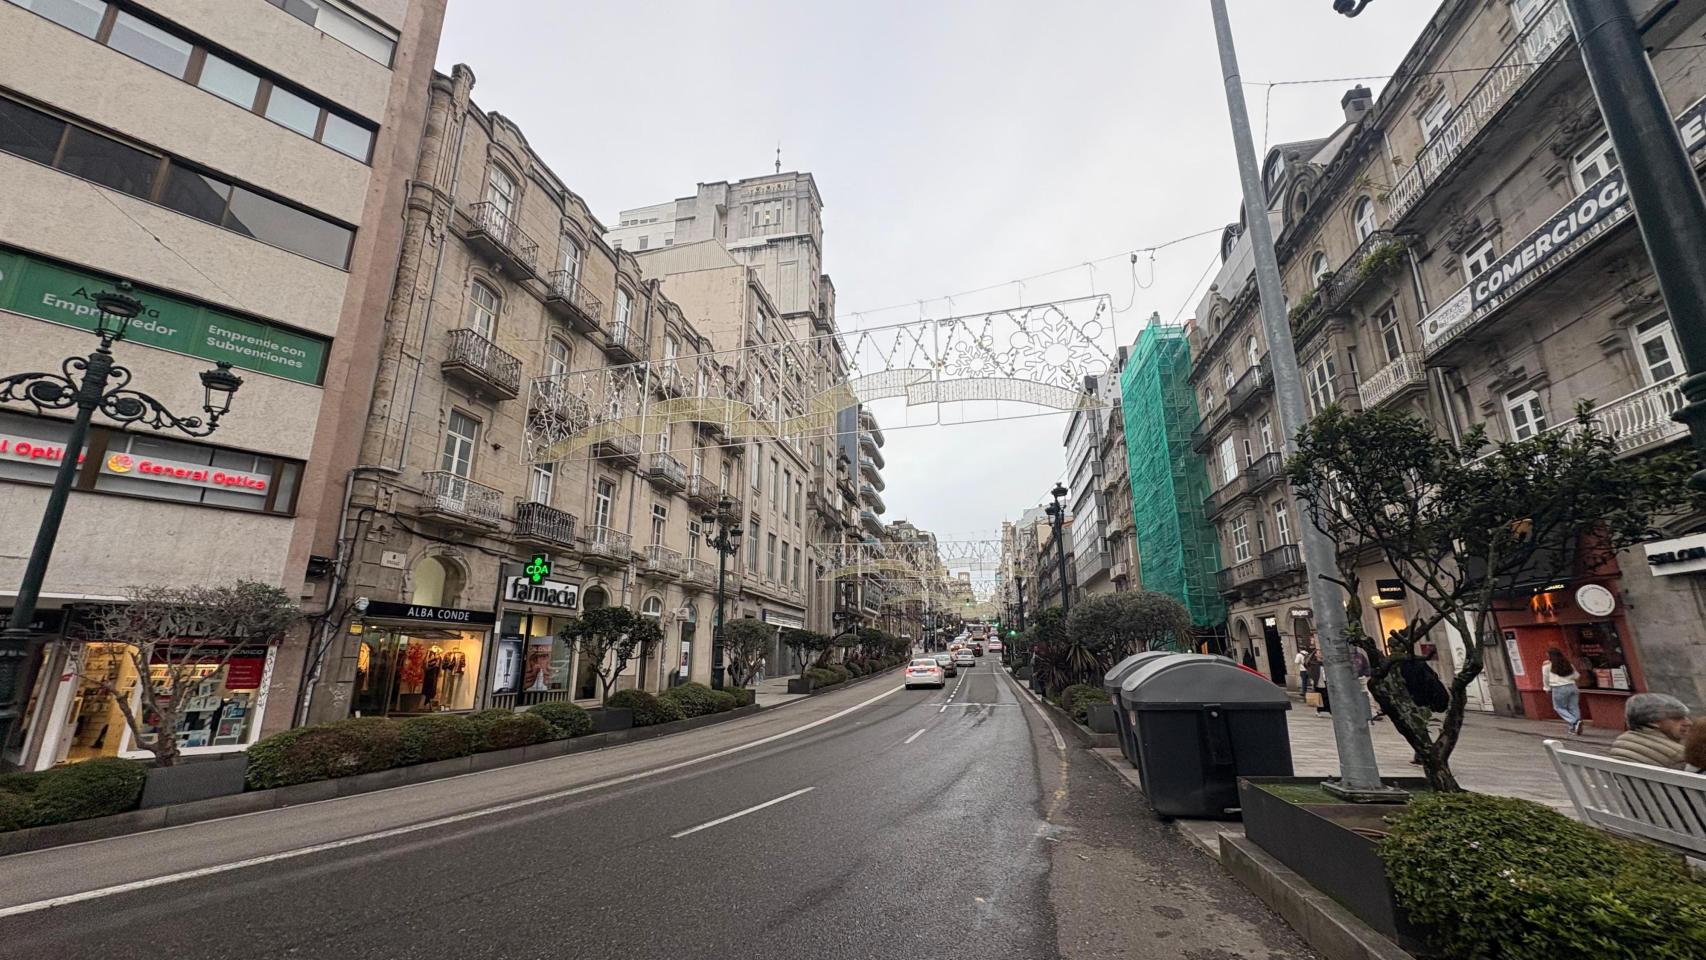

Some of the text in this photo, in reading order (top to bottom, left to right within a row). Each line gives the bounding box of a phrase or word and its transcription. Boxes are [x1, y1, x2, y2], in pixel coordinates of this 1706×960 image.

[206, 336, 304, 369] Subvenciones
[208, 324, 306, 358] Emprende con
[137, 459, 266, 490] General Optica
[525, 565, 549, 574] CDA
[408, 607, 470, 620] ALBA CONDE
